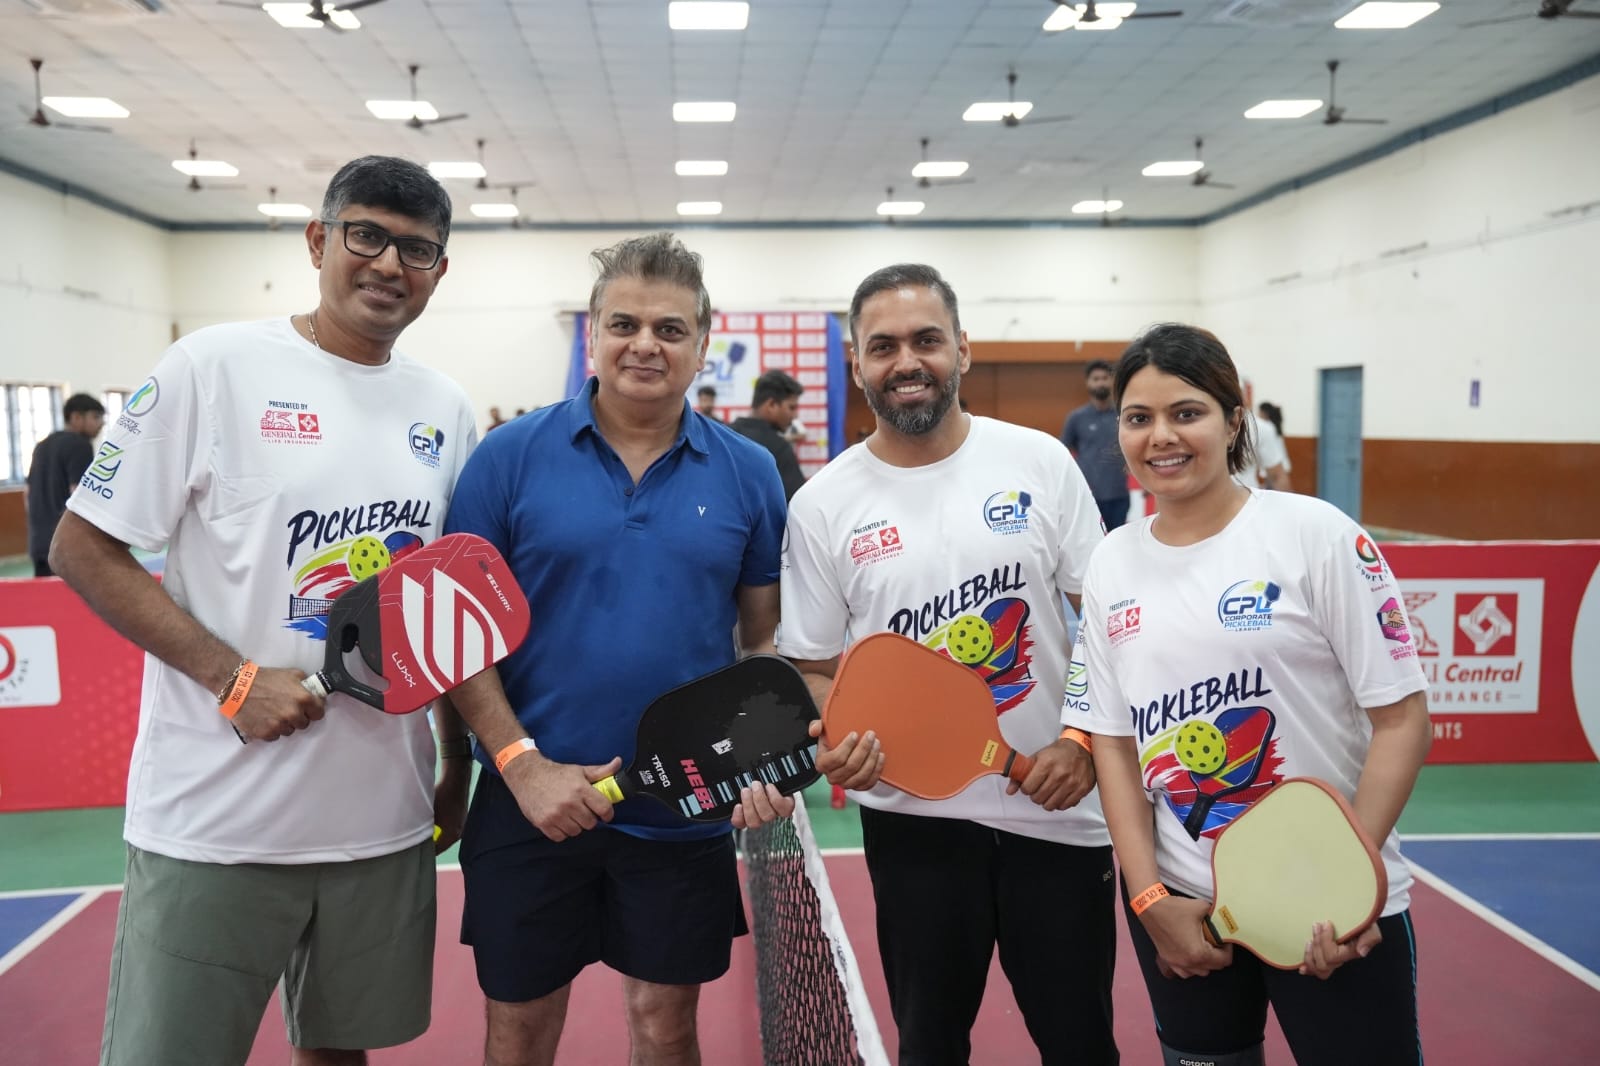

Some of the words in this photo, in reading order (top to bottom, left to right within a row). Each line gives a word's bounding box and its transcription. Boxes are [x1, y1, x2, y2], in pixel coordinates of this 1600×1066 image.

[698, 360, 733, 381] PL
[268, 400, 300, 410] PRESENTED
[300, 403, 308, 411] BY
[260, 430, 297, 439] GENERALI
[297, 432, 322, 441] Central
[412, 434, 441, 456] CPL
[82, 473, 114, 500] EMO
[988, 503, 1028, 522] CPL
[853, 520, 881, 535] PRESENTED
[880, 519, 888, 527] BY
[991, 518, 1029, 528] CORPORATE
[992, 523, 1029, 533] PICKLEBALL
[286, 499, 433, 571] PICKLEBALL
[881, 543, 904, 556] Central
[485, 573, 514, 613] SELKIRK
[887, 561, 1027, 642] PICKLEBALL
[1222, 596, 1273, 616] CPL
[1224, 613, 1273, 622] CORPORATE
[1224, 620, 1273, 629] PICKLEBALL
[391, 651, 417, 688] LUXX
[1444, 660, 1524, 683] Central
[1064, 696, 1091, 712] MO
[1431, 689, 1503, 703] URANCE
[1433, 721, 1463, 740] NTS
[645, 769, 656, 785] USA
